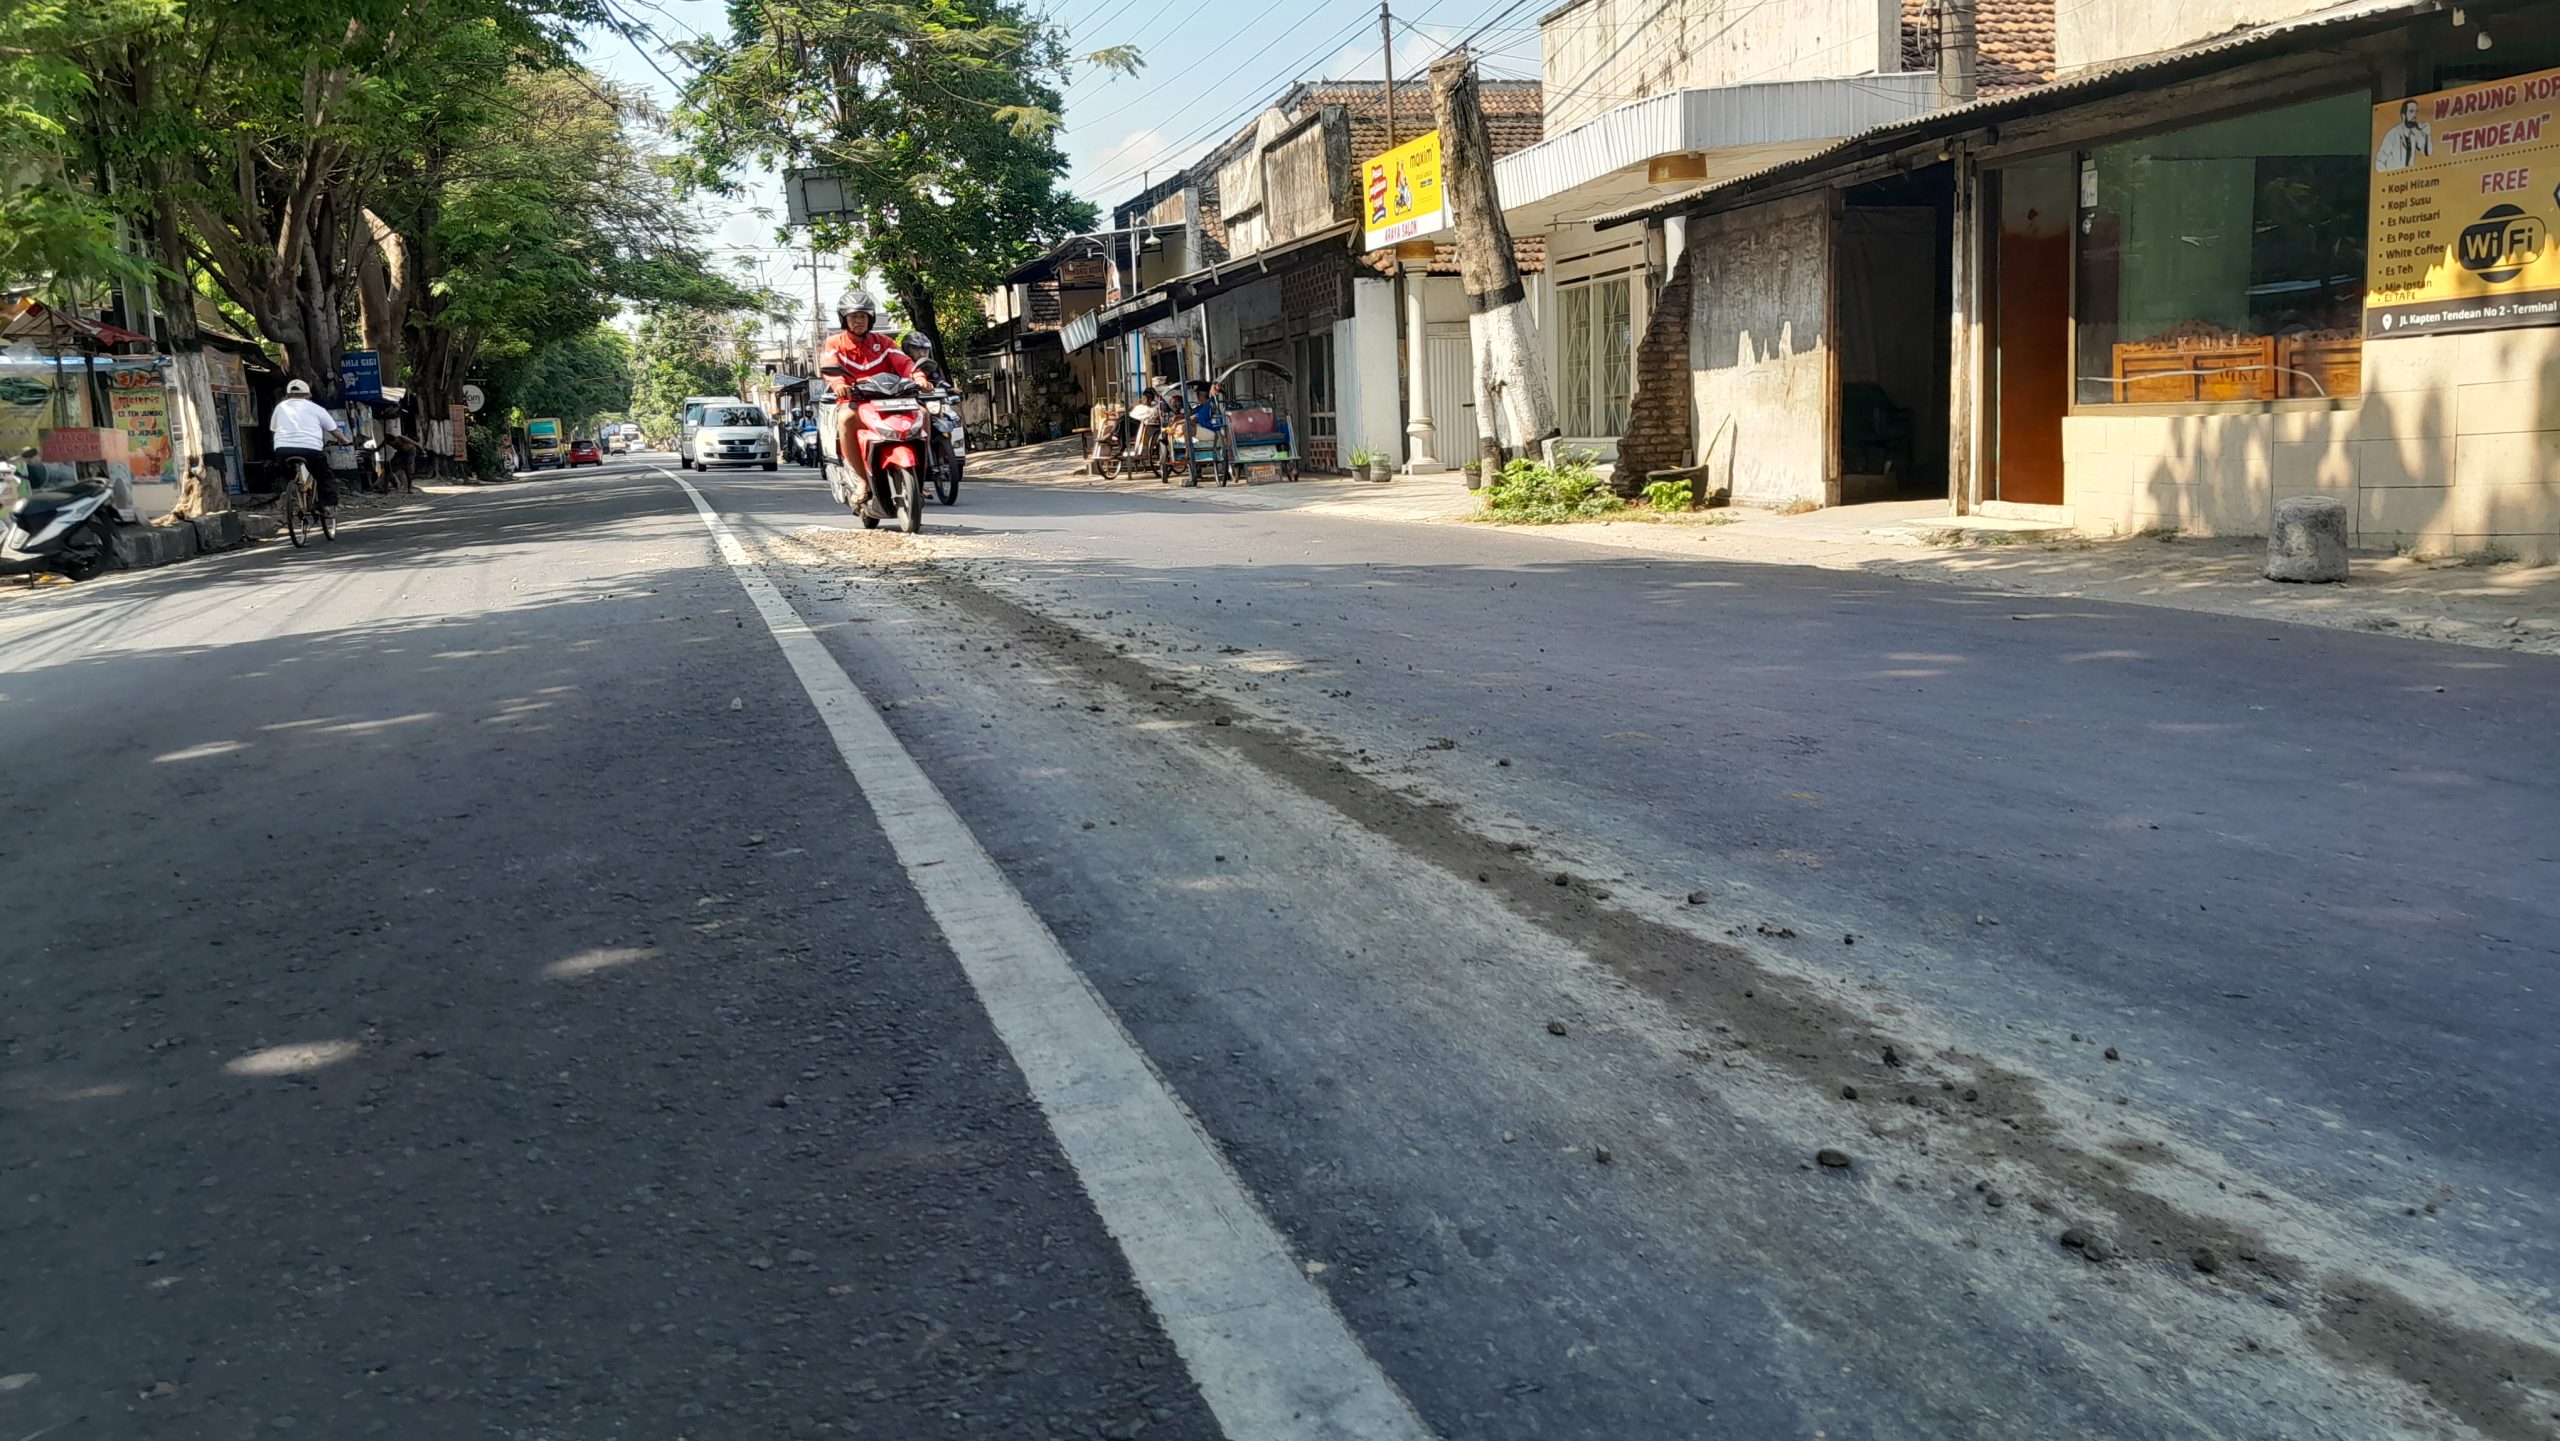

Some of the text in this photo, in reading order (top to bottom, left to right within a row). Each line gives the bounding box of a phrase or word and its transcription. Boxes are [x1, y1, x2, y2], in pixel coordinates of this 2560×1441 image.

[2435, 85, 2517, 119] WARUNG
[2388, 178, 2440, 196] Kopi Hitam
[2481, 168, 2529, 194] FREE
[2388, 196, 2431, 212] Kopi Susu
[2387, 210, 2440, 227] Es Nutrisari
[2387, 229, 2431, 243] Es Pop Ice
[2386, 243, 2445, 260] White Coffee
[2385, 264, 2413, 276] Es Teh
[2385, 279, 2433, 291] Mie Instan
[2409, 313, 2441, 326] Kapten
[2442, 309, 2482, 321] Tendean
[2483, 307, 2497, 317] No
[2498, 306, 2506, 316] 2
[2512, 301, 2557, 315] Terminal
